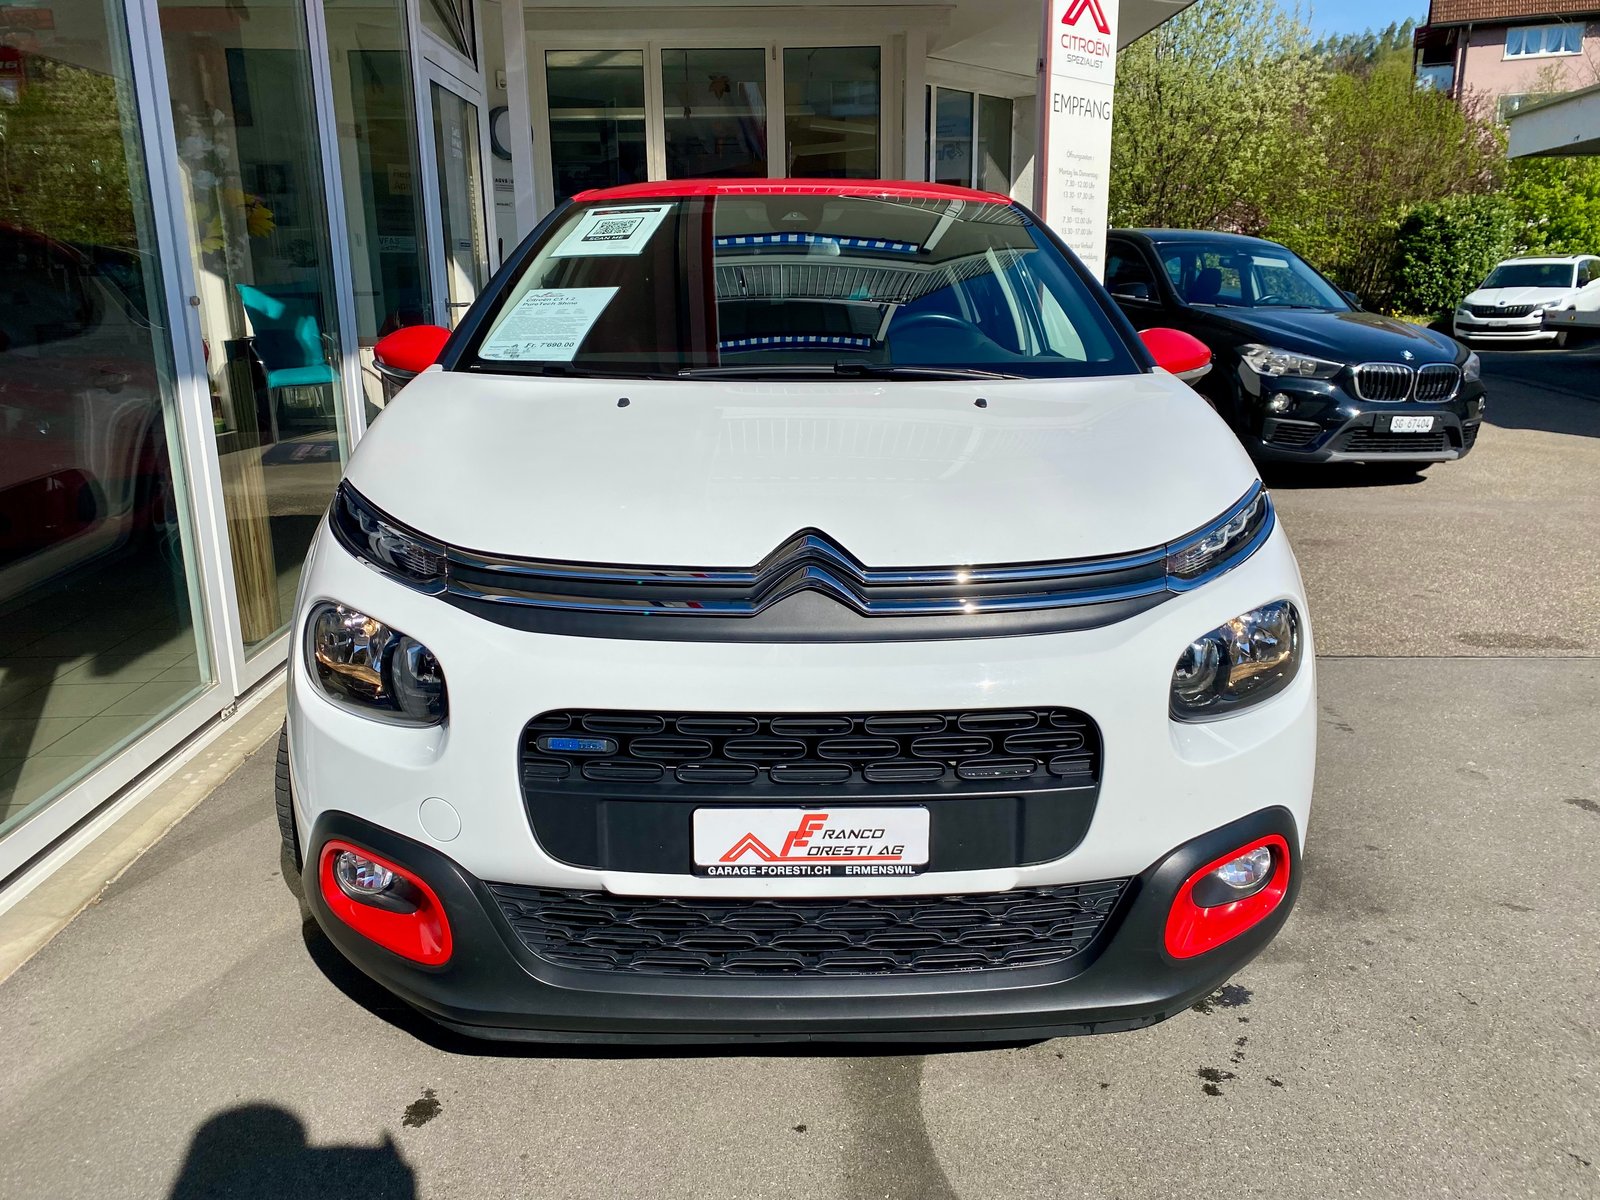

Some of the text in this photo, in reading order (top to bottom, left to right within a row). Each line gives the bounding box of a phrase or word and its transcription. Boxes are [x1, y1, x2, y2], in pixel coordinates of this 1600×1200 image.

[1061, 34, 1110, 57] CITROËN
[1067, 54, 1103, 69] SPEZIALIST
[1054, 93, 1110, 120] EMPFANG
[1394, 419, 1430, 428] SG 67404
[876, 845, 905, 855] AG
[708, 865, 915, 876] GARAGE-FORESTI.CH ERMENSWIL
